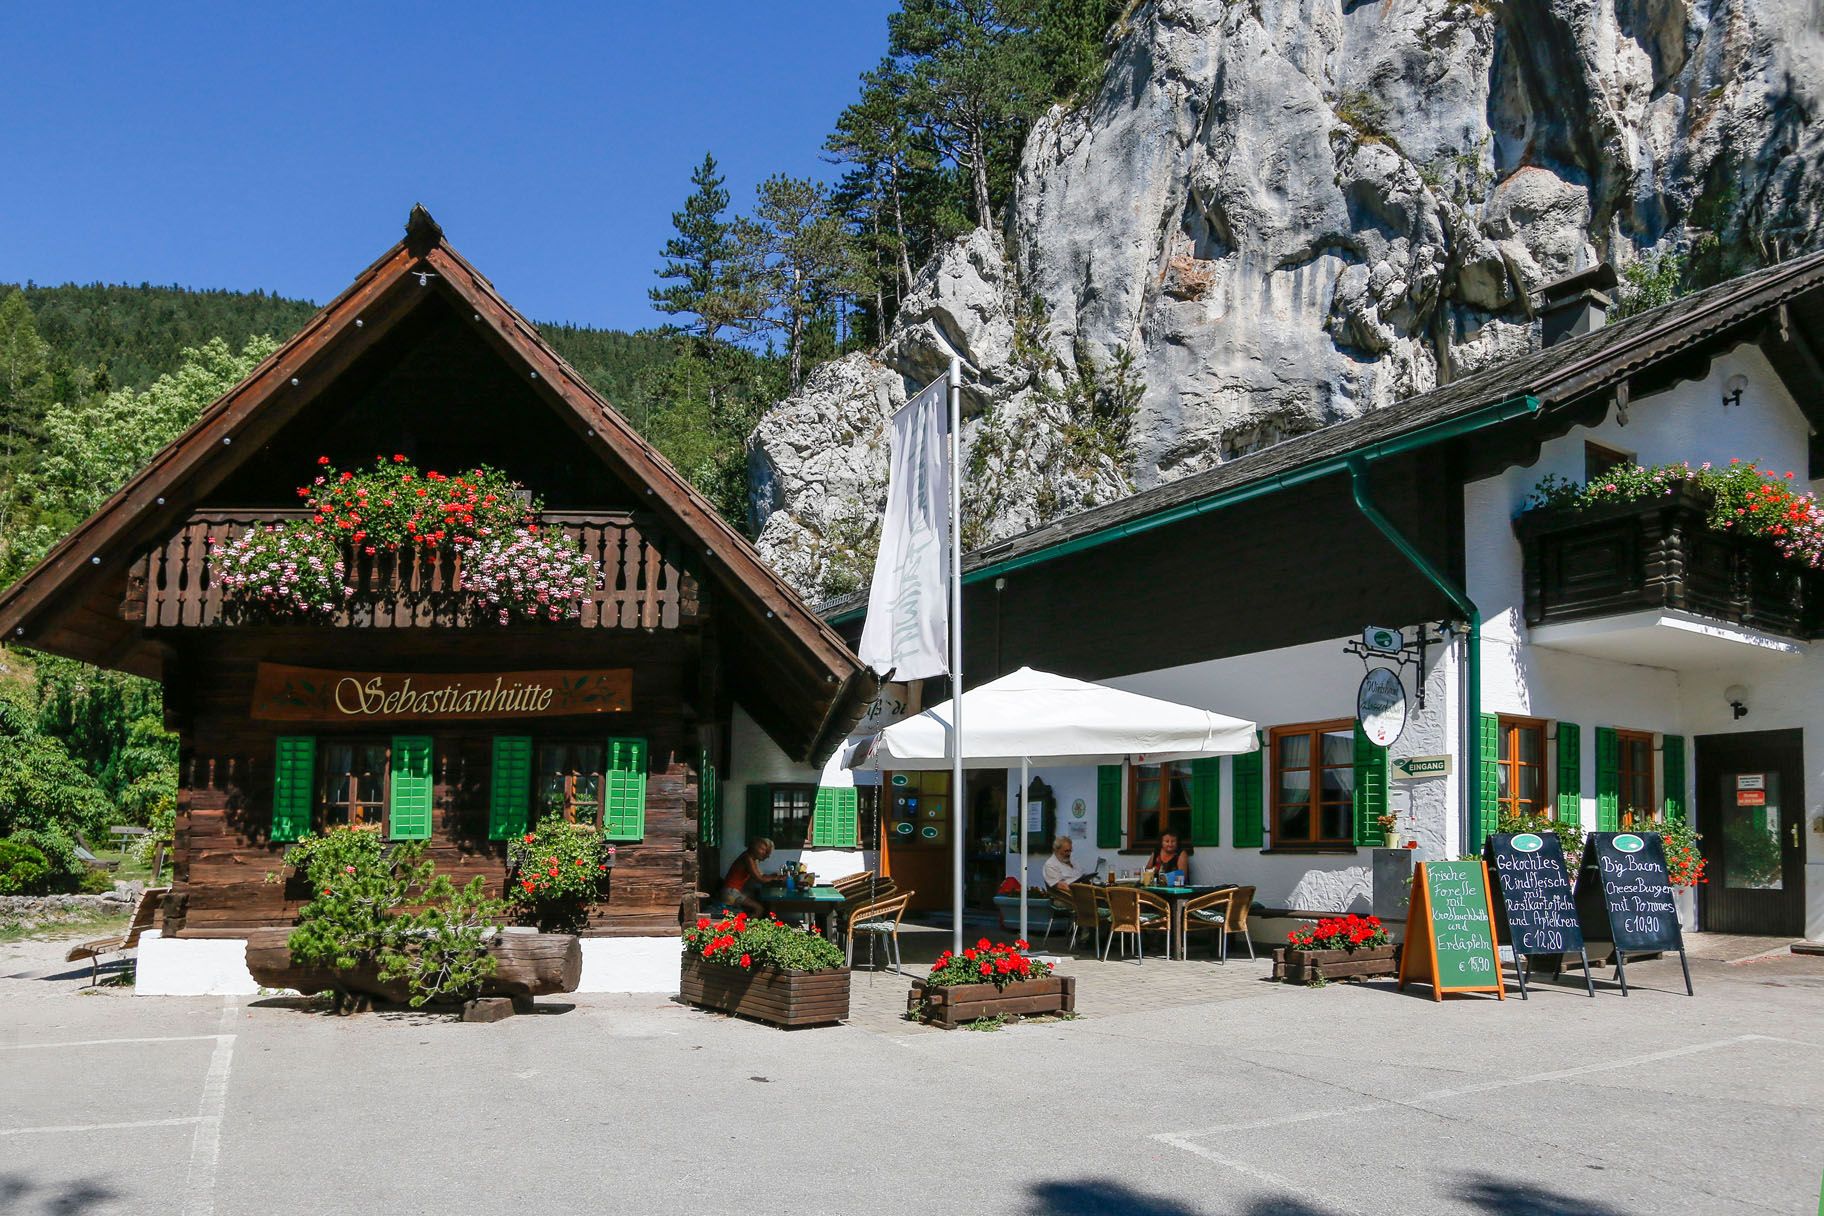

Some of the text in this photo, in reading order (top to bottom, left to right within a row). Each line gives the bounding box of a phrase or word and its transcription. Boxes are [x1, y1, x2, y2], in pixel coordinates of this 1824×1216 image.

[335, 676, 553, 715] Sebastianhütte
[1409, 762, 1444, 771] EINGANG
[1496, 852, 1560, 871] Gekochtes
[1601, 854, 1662, 877] Big Bacon
[1428, 865, 1466, 881] Frische
[1500, 871, 1567, 890] Rindfleisch
[1434, 881, 1477, 896] Forelle
[1524, 888, 1545, 898] mit
[1447, 897, 1465, 906] mit
[1505, 895, 1575, 911] Röstkartoffeln
[1611, 896, 1675, 913] mit Pommes
[1447, 920, 1469, 931] und
[1509, 911, 1530, 926] und
[1437, 934, 1491, 952] Erdäpfeln
